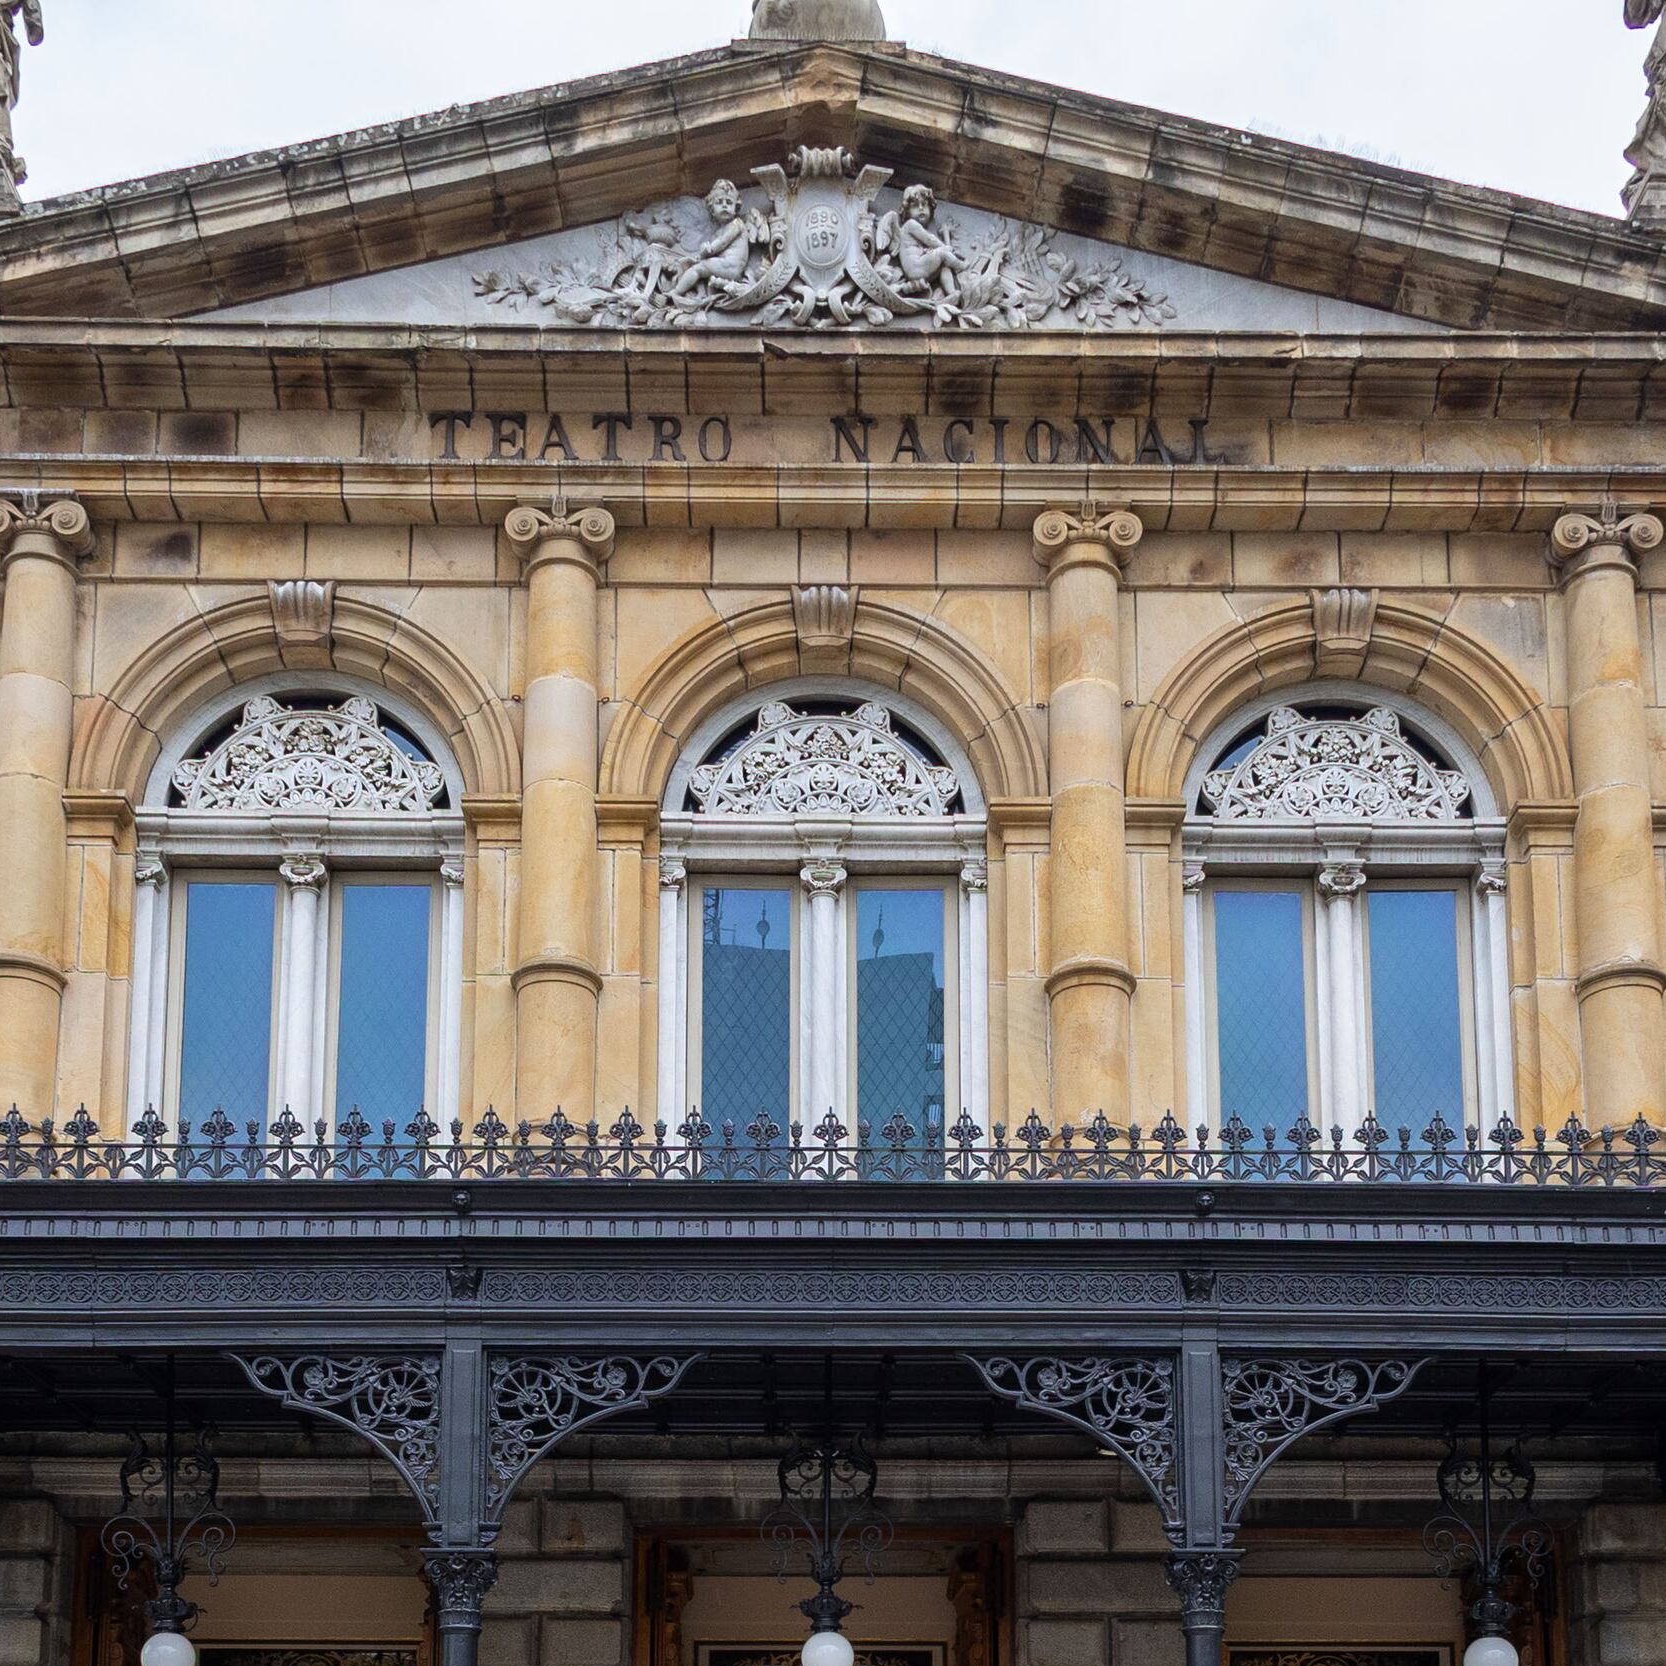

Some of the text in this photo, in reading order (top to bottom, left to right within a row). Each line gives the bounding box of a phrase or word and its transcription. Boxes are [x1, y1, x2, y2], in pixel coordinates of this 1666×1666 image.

[805, 211, 839, 227] 1890
[805, 231, 839, 251] 1897
[428, 411, 1228, 464] TEATRO NACIONAL
